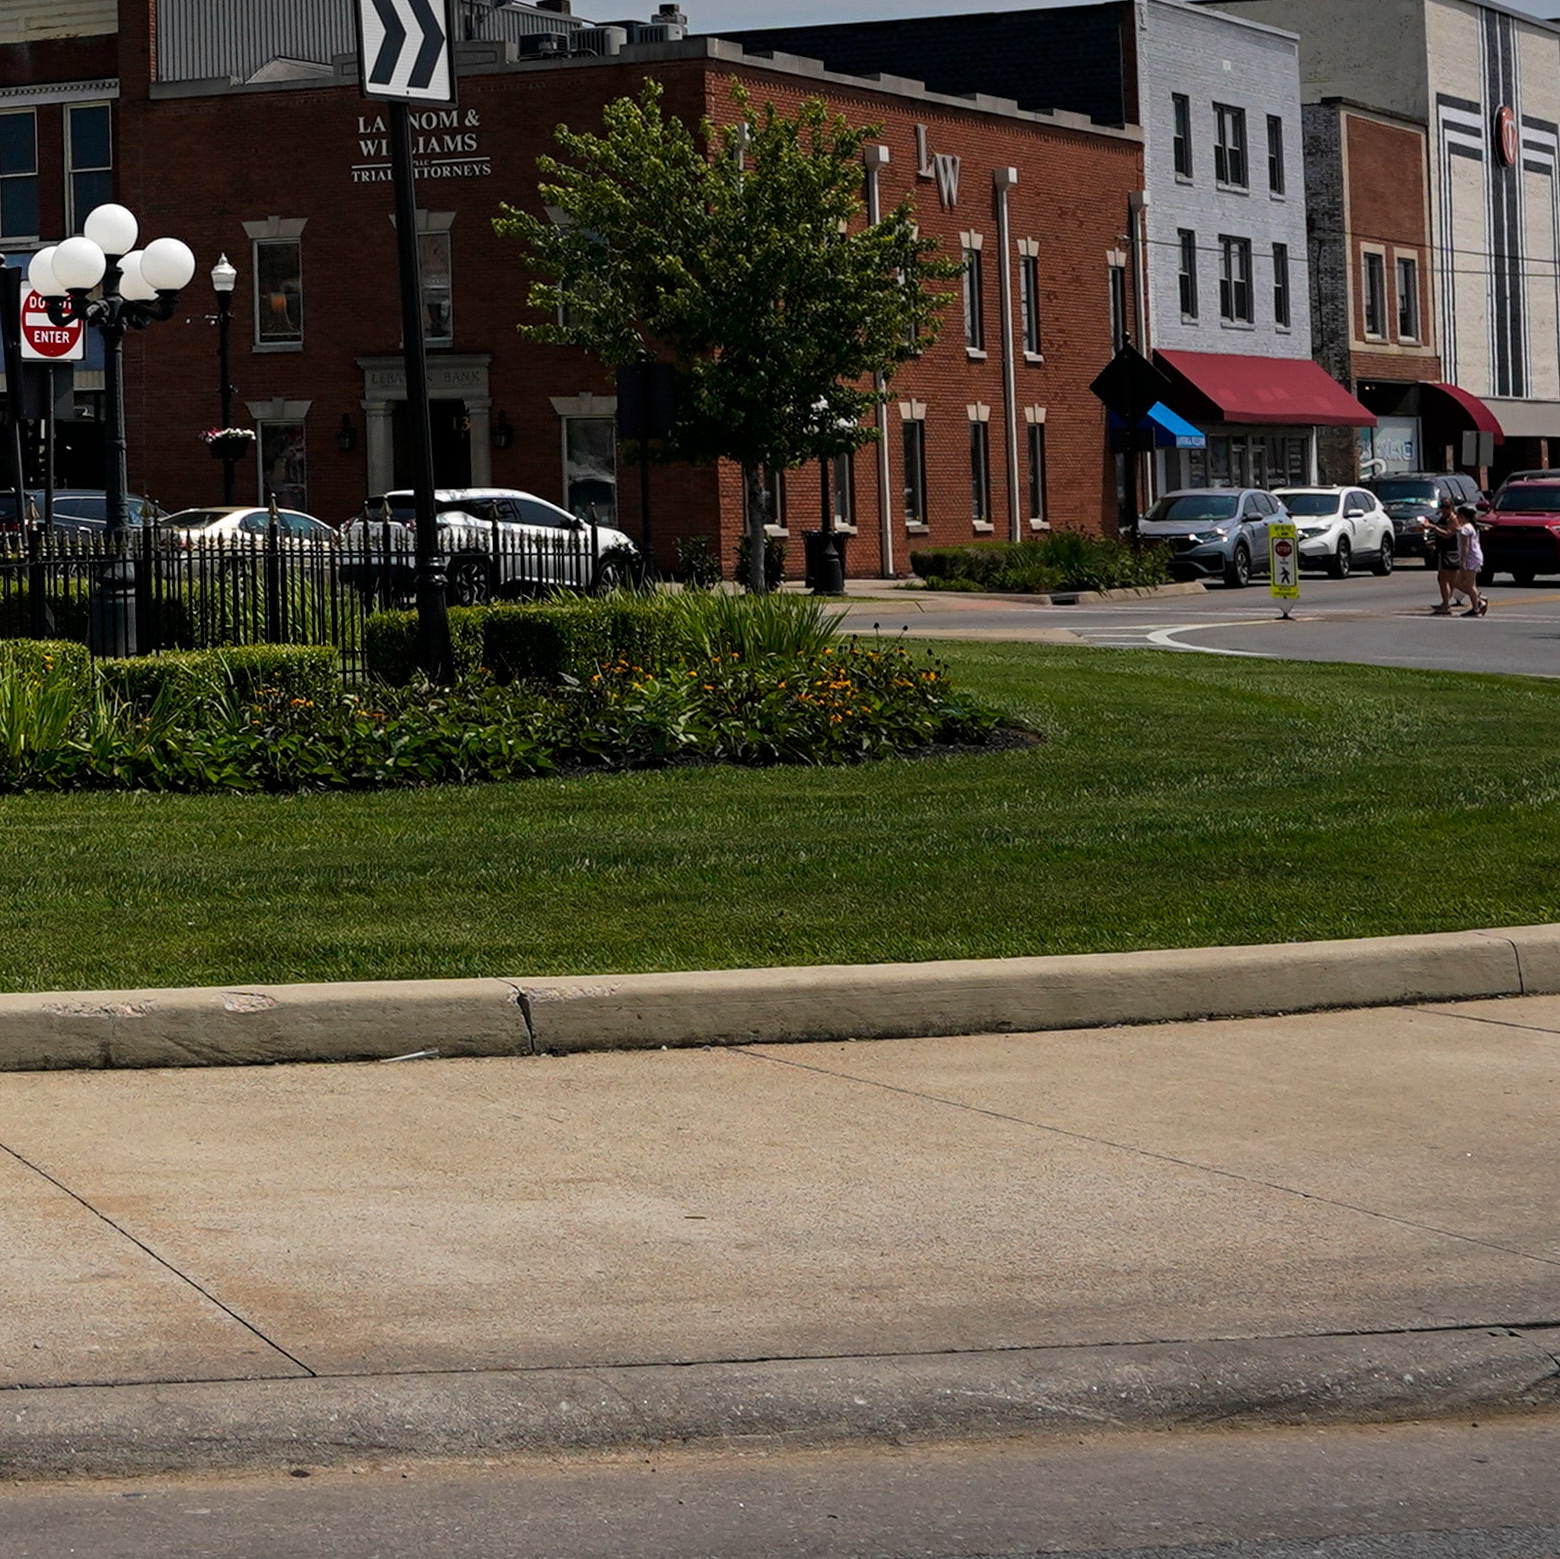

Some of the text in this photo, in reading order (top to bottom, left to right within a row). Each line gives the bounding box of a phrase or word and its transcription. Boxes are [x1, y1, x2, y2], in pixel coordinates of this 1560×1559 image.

[358, 108, 481, 134] LANOM &
[359, 132, 479, 157] WIIAMS
[414, 162, 492, 180] TTORNEYS
[33, 330, 70, 344] ENTER
[443, 370, 481, 382] BANK
